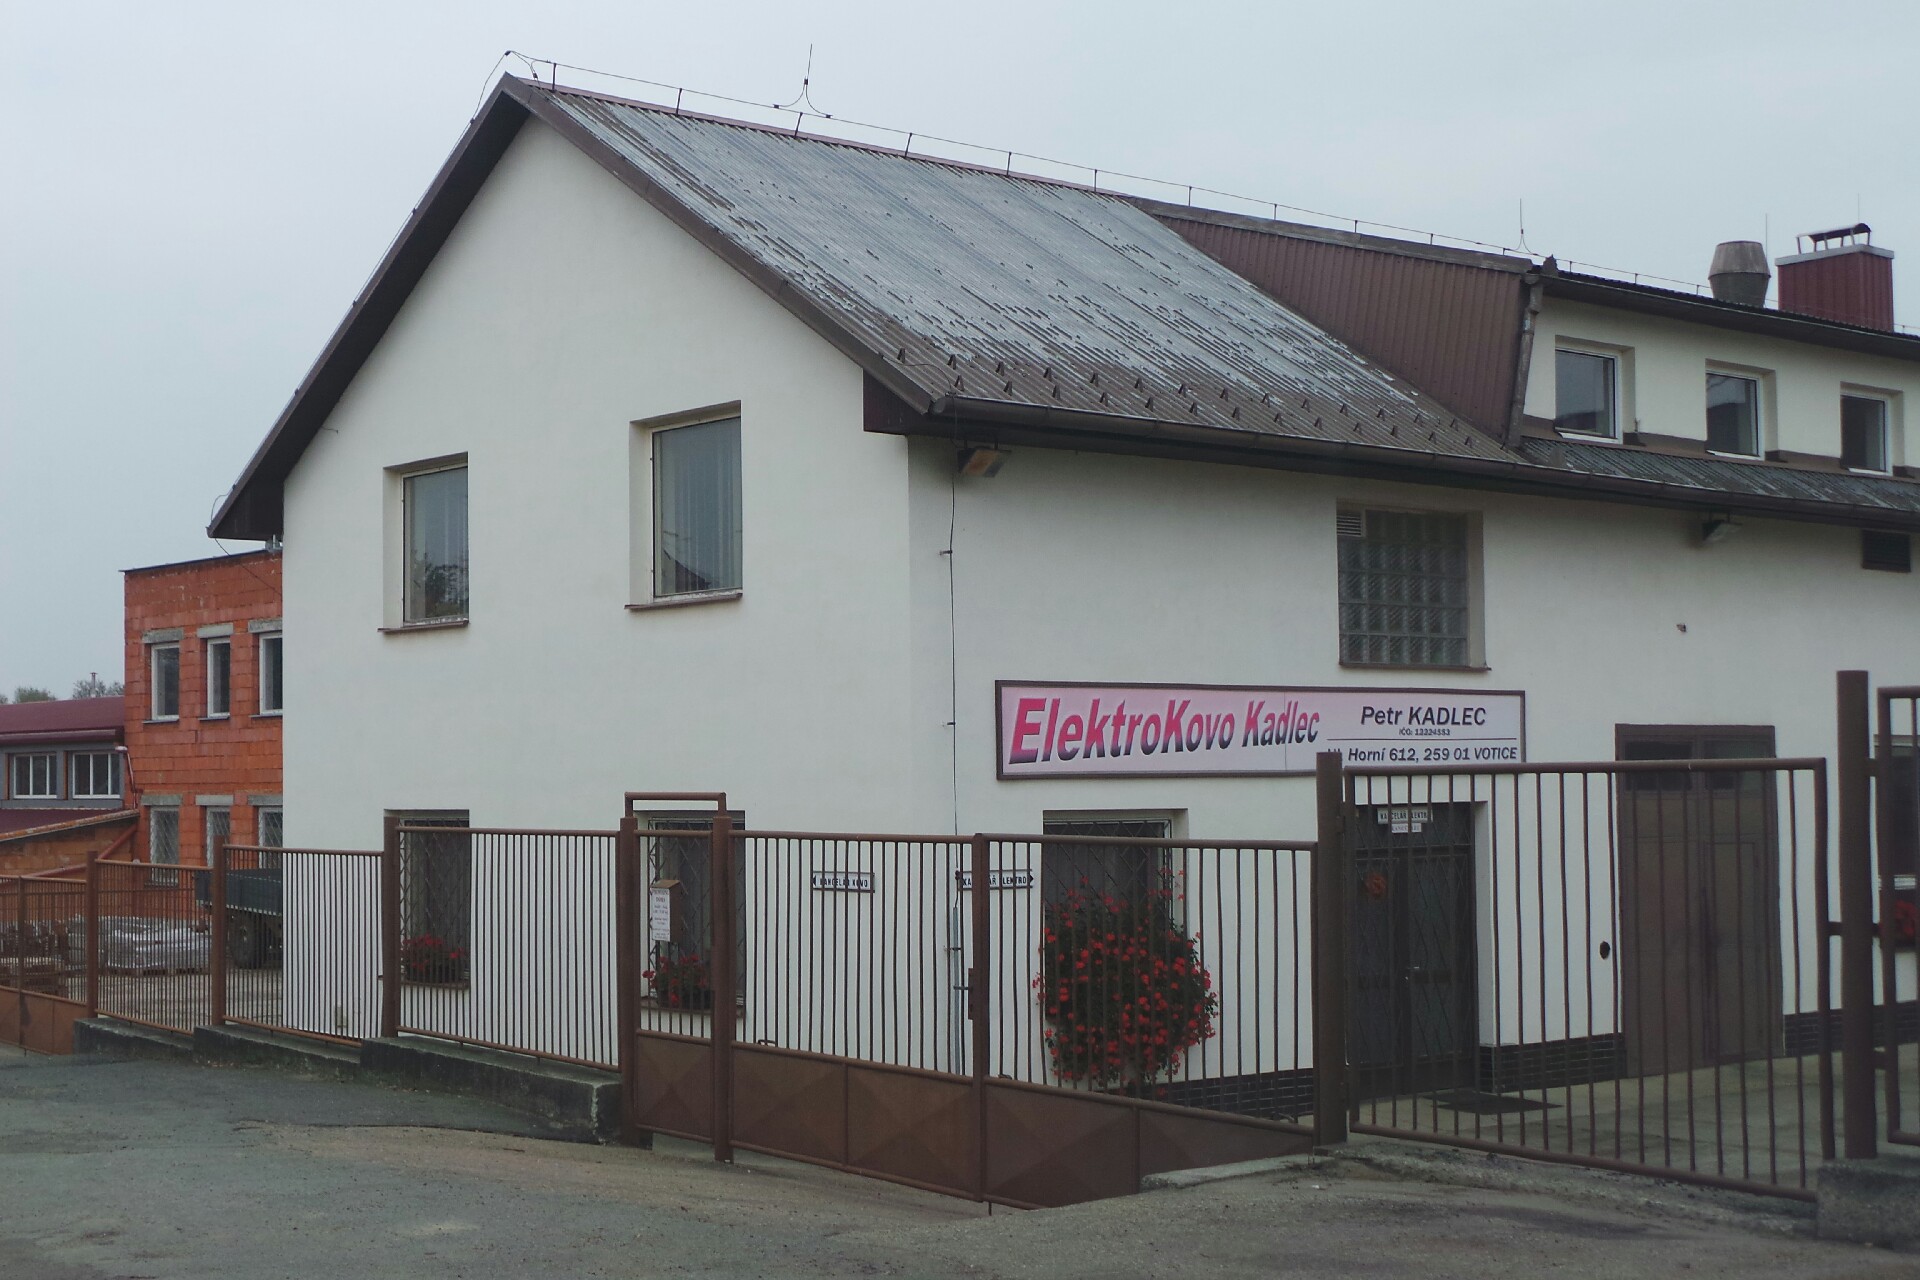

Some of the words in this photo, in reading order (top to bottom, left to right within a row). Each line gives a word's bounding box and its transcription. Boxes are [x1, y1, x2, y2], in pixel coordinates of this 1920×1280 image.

[1360, 705, 1403, 726] Petr
[1408, 705, 1487, 726] KADLEC
[1008, 697, 1235, 765] ElektroKovo
[1241, 699, 1320, 748] Kadlec
[1347, 747, 1386, 762] Horní
[1389, 747, 1420, 764] 612,
[1423, 747, 1450, 761] 259
[1453, 747, 1471, 761] 01
[1474, 746, 1518, 761] VOTICE
